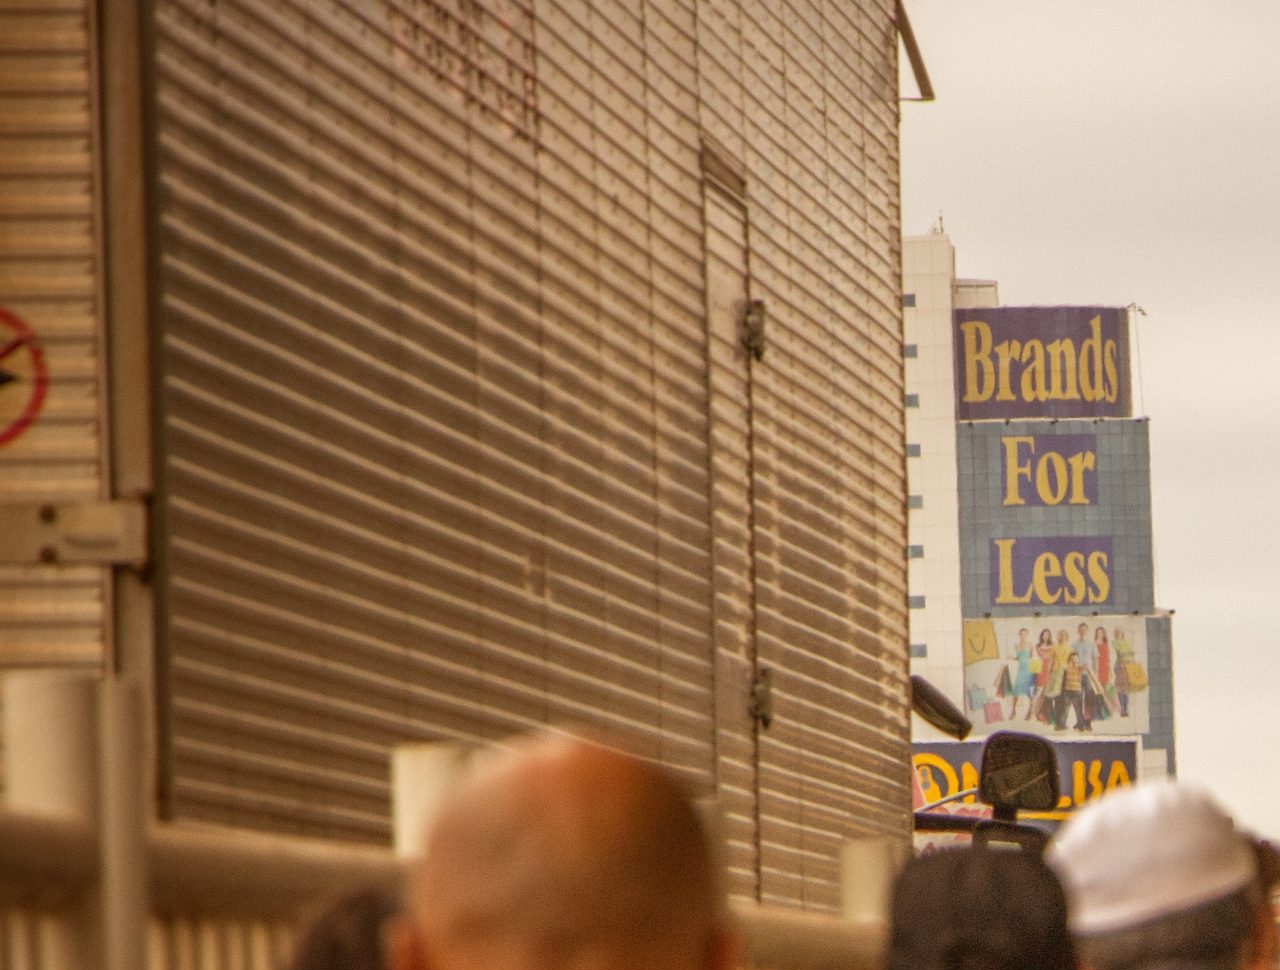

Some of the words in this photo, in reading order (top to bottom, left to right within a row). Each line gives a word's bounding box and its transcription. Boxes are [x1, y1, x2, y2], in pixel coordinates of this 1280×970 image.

[959, 315, 1119, 403] Brands
[1001, 435, 1097, 507] For
[994, 538, 1110, 606] Less
